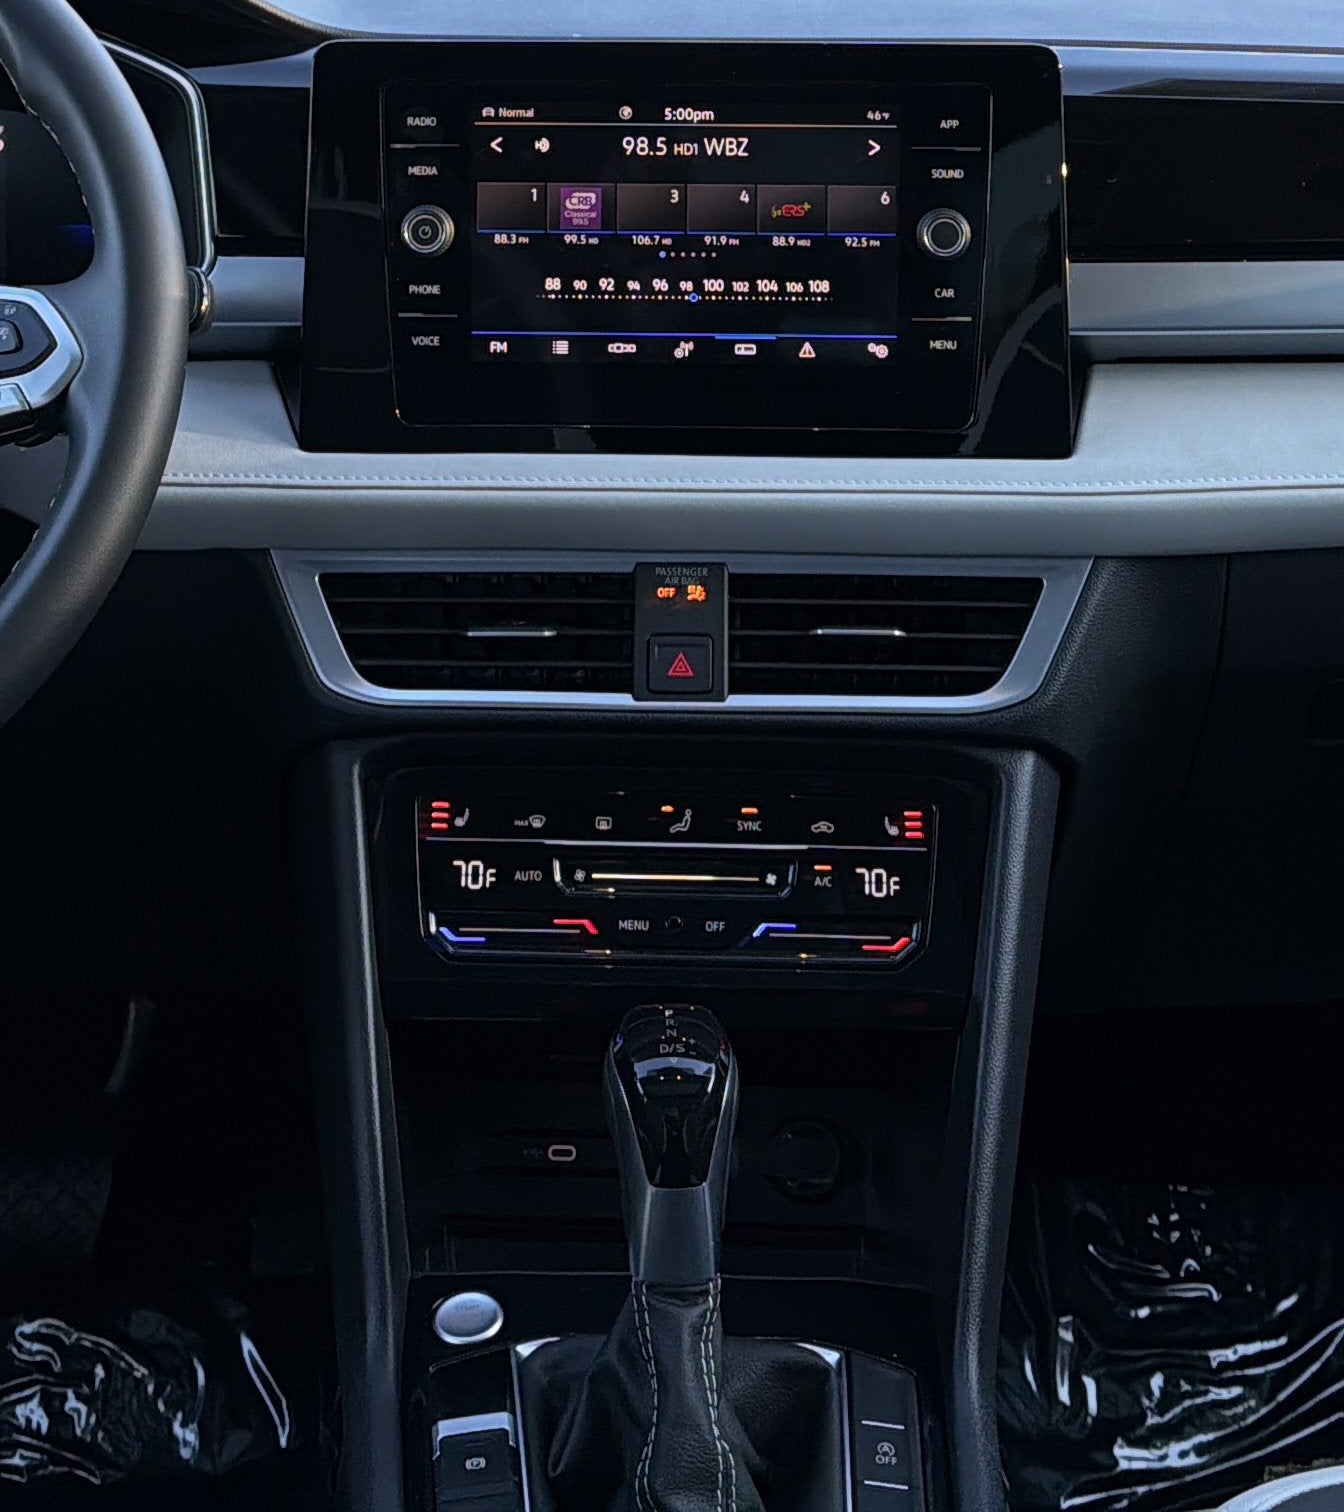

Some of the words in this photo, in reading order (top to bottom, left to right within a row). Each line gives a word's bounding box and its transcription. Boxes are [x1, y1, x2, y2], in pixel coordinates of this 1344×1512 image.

[499, 107, 535, 118] Normal
[664, 107, 715, 123] 5:00pm
[406, 116, 437, 126] RADIO
[939, 120, 959, 129] APP
[622, 136, 667, 156] 98.5
[673, 143, 699, 156] HD1
[704, 137, 750, 156] WBZ
[408, 166, 438, 176] MEDIA
[931, 169, 964, 179] SOUND
[530, 188, 537, 202] 1
[670, 190, 679, 203] 3
[739, 190, 750, 203] 4
[880, 191, 890, 204] 6
[493, 234, 517, 245] 88.3
[563, 234, 587, 245] 99.5
[631, 235, 660, 246] 106.7
[703, 235, 727, 246] 91.9
[772, 236, 796, 247] 88.9
[844, 237, 868, 248] 92.5
[408, 284, 441, 295] PHONE
[544, 277, 562, 291] 88
[573, 279, 588, 291] 90
[598, 278, 615, 291] 92
[626, 280, 641, 291] 94
[652, 278, 669, 291] 96
[679, 280, 694, 291] 98
[702, 278, 725, 292] 100
[732, 281, 750, 292] 102
[756, 279, 779, 293] 104
[785, 281, 804, 293] 106
[808, 280, 830, 293] 108
[934, 288, 955, 298] CAR
[411, 336, 441, 346] VOICE
[930, 340, 958, 350] MENU
[489, 341, 508, 353] FM
[655, 566, 709, 577] PASSENGER
[664, 576, 679, 584] AIR
[657, 586, 676, 599] OFF
[736, 820, 762, 832] SYNC
[514, 870, 543, 882] AUTO
[813, 876, 833, 888] A/C
[618, 920, 650, 931] MENU
[705, 921, 726, 932] OFF
[664, 1009, 674, 1017] P
[665, 1018, 675, 1026] R
[666, 1028, 677, 1037] N
[659, 1043, 686, 1054] D/S
[874, 1454, 898, 1466] OFF
